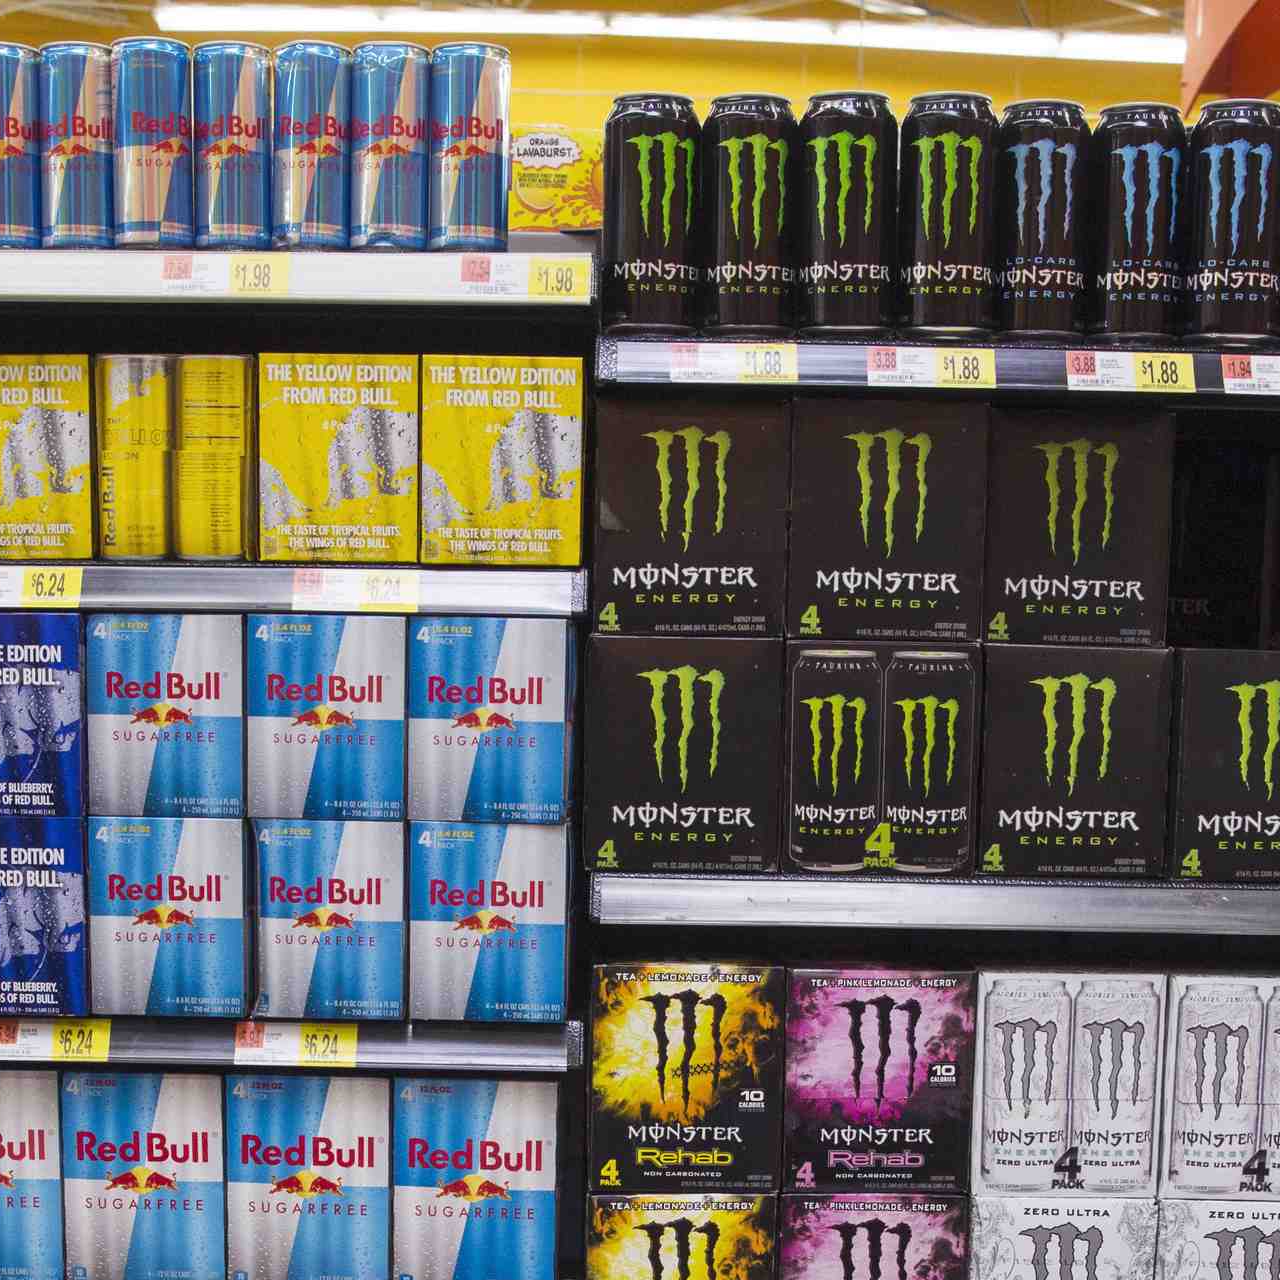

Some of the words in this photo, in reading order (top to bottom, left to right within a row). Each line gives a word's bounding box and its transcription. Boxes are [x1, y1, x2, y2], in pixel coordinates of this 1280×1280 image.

[1006, 256, 1076, 266] LO-CARB
[800, 260, 890, 282] MONSTER
[26, 366, 82, 382] EDITION
[2, 388, 29, 404] RED
[32, 572, 66, 598] $6.24
[613, 564, 758, 588] MONSTER
[636, 594, 736, 603] ENERGY
[598, 602, 618, 625] 4
[6, 646, 60, 664] EDITION
[23, 668, 60, 685] BULL.
[106, 672, 161, 699] Red
[166, 672, 220, 700] Bull
[113, 730, 216, 744] SUGARFREE
[740, 1090, 765, 1102] 10
[628, 1123, 742, 1144] MONSTER
[636, 1147, 732, 1167] Rehab
